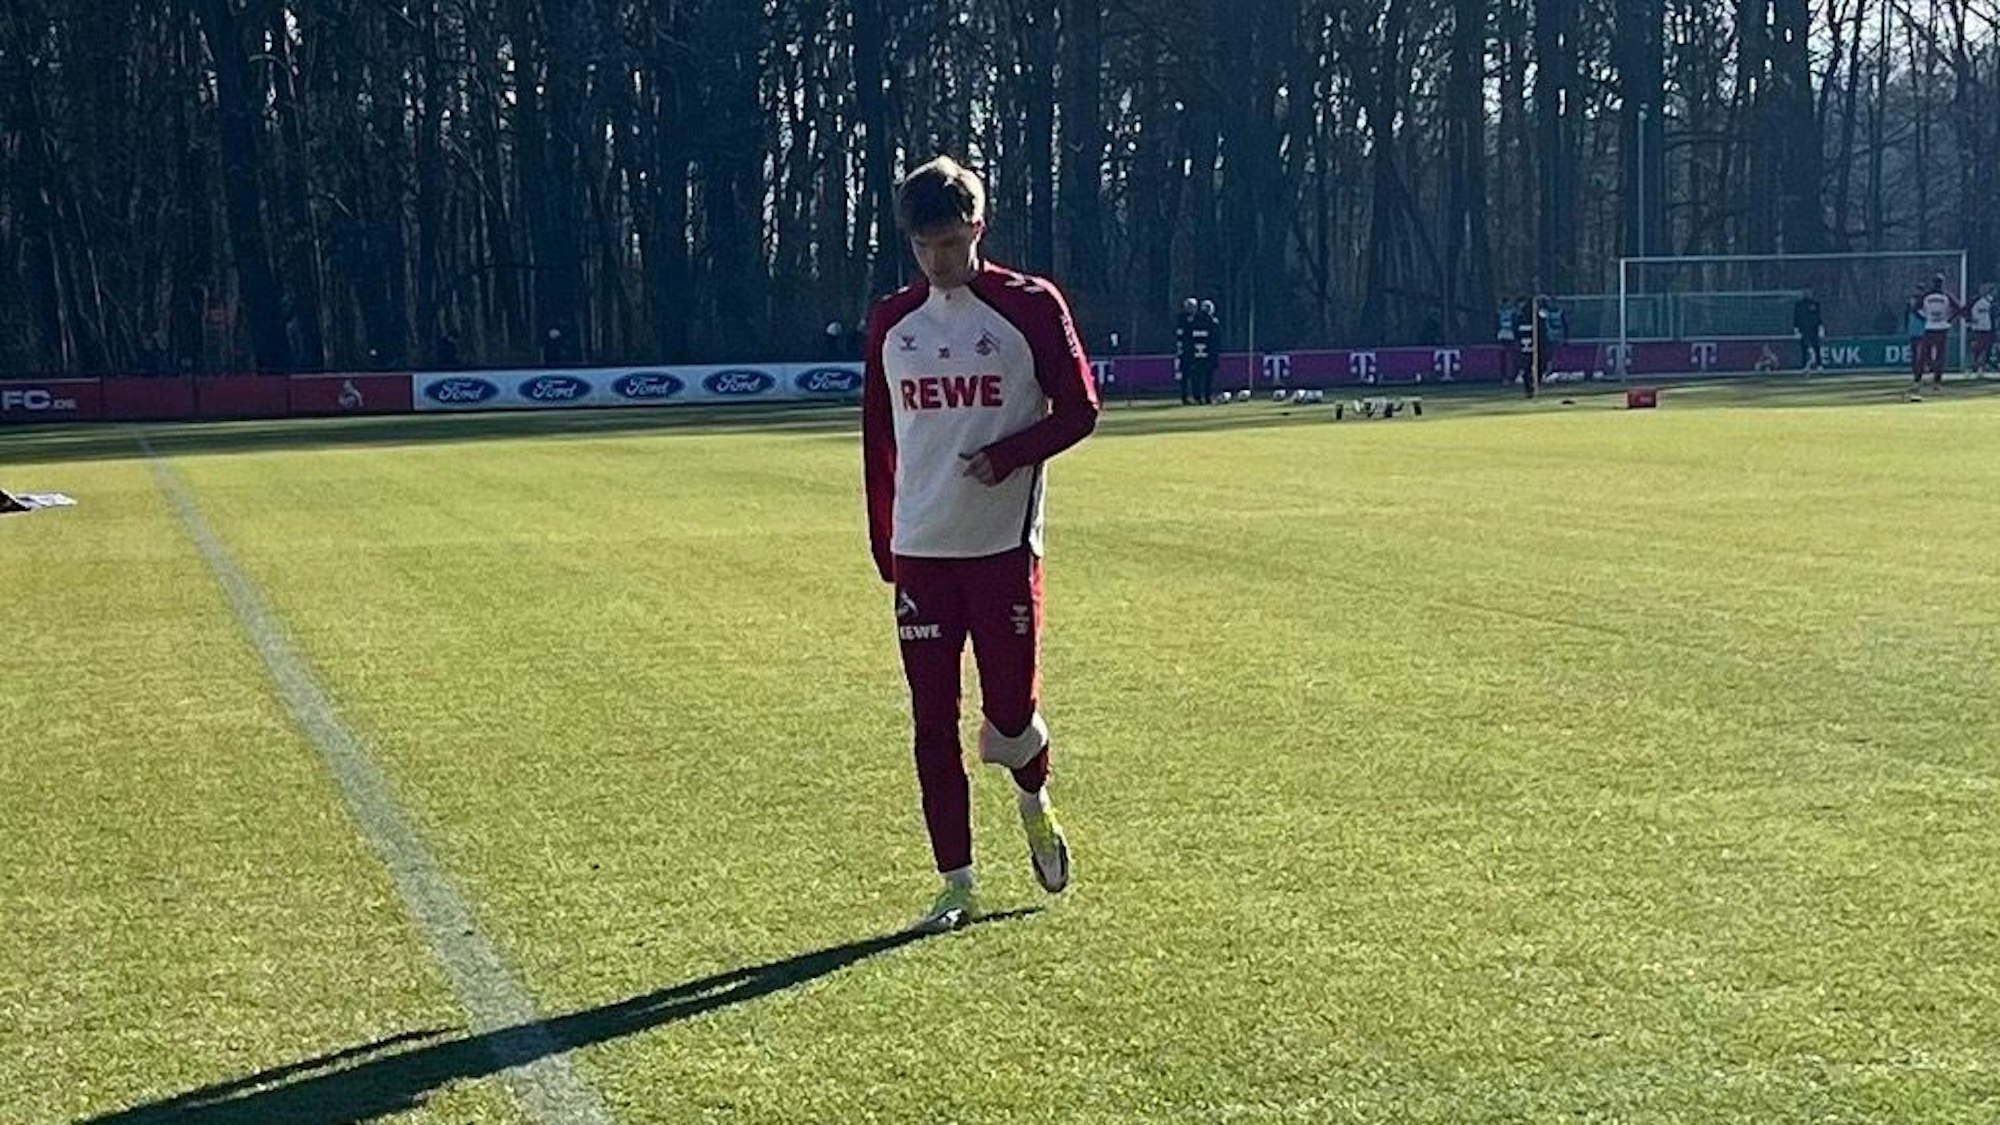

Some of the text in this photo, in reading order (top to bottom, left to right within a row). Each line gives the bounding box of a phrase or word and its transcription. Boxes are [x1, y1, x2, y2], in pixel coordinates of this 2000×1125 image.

[439, 381, 484, 400] Ford
[532, 379, 578, 398] Ford
[625, 376, 671, 396] Ford
[716, 373, 761, 392] Ford
[808, 371, 852, 391] Ford
[901, 375, 1003, 410] REWE
